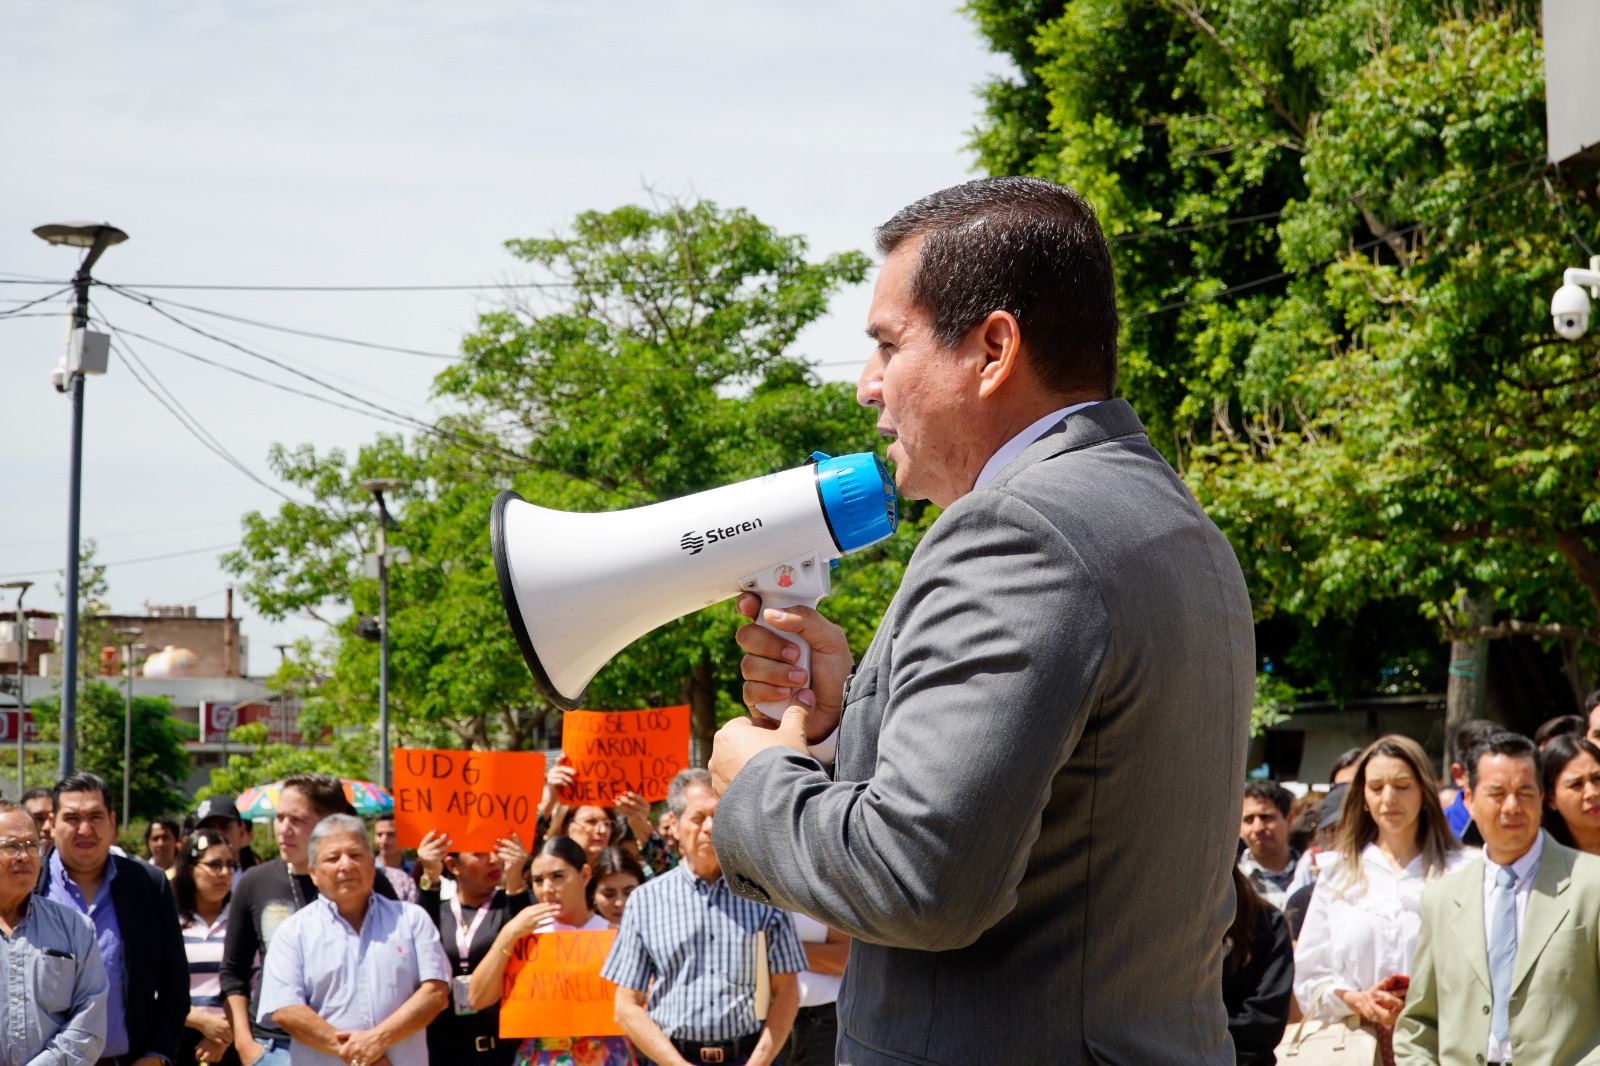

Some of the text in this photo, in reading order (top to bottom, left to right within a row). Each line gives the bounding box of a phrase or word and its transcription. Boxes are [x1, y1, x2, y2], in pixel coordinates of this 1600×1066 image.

[705, 518, 763, 544] Steren
[604, 714, 627, 734] SE
[636, 710, 671, 732] LOS
[639, 754, 680, 781] LOS
[399, 788, 529, 825] EN APOYO
[512, 933, 611, 966] NO MA
